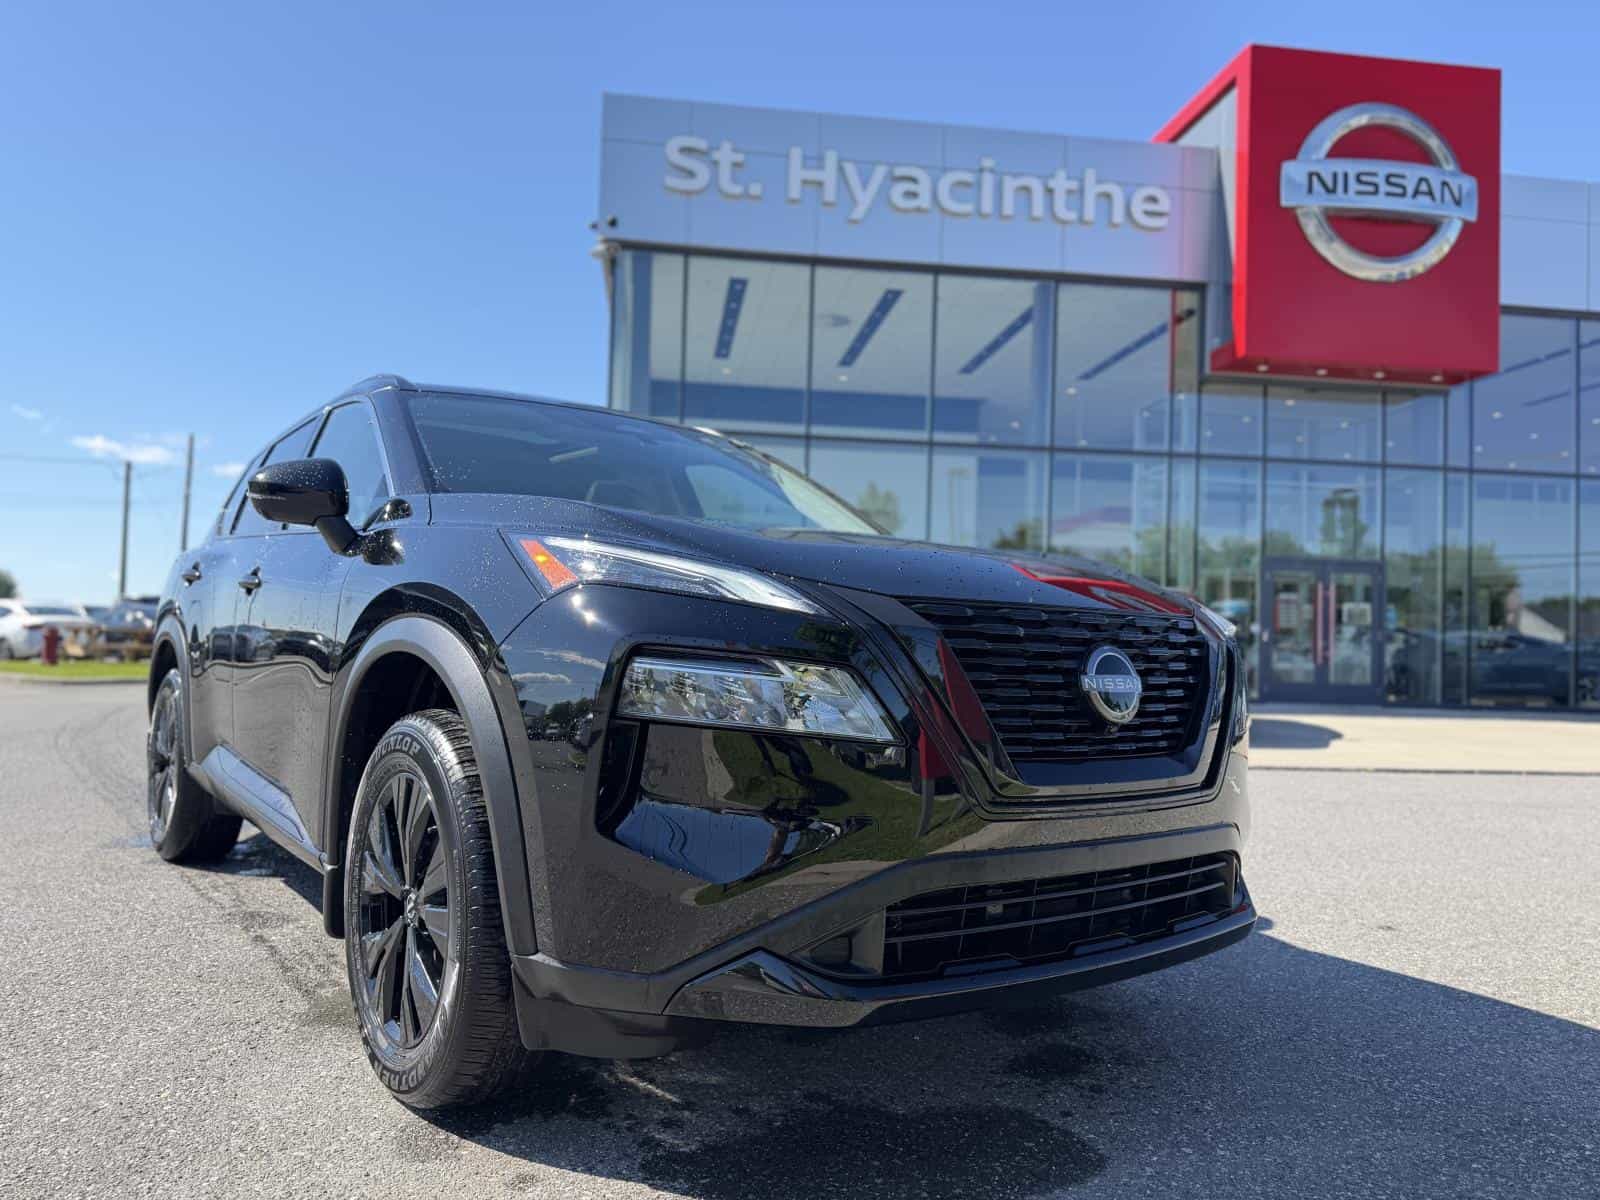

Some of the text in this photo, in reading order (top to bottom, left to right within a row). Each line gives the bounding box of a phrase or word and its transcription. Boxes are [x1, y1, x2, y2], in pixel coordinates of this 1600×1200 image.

[665, 135, 1171, 229] St. Hyacinthe
[1306, 170, 1463, 208] NISSAN
[374, 734, 420, 763] DUNLOP
